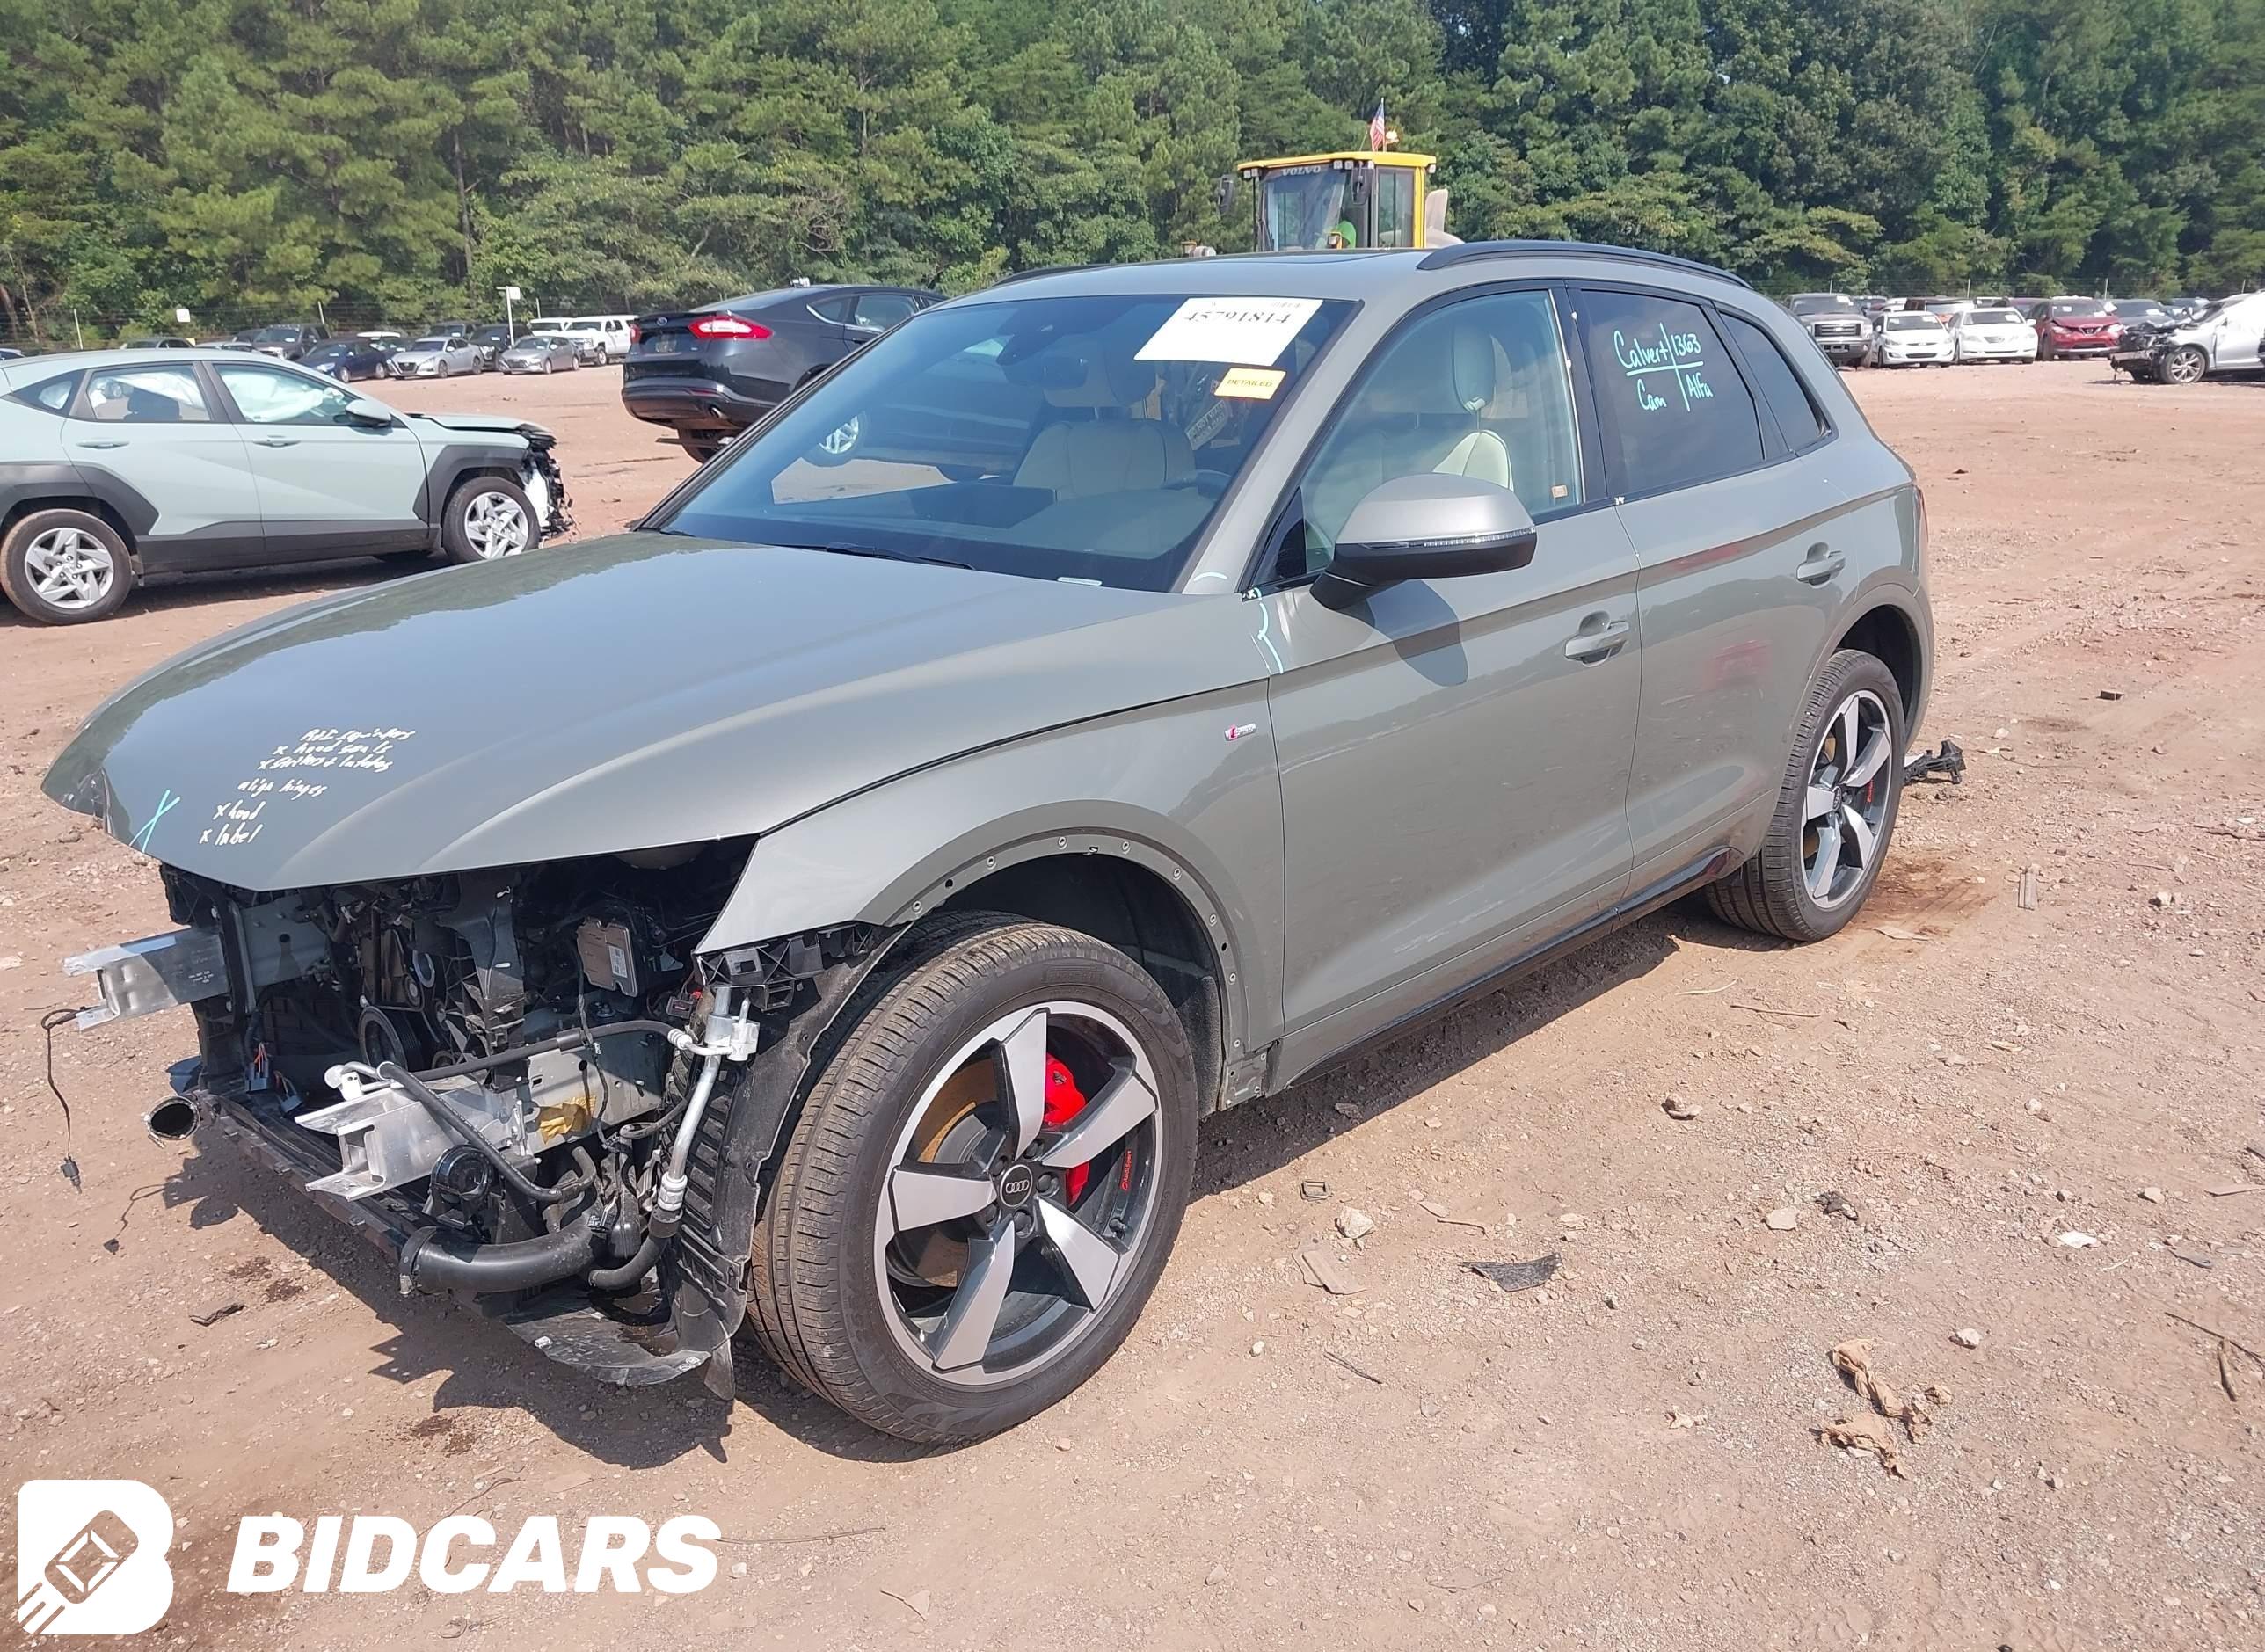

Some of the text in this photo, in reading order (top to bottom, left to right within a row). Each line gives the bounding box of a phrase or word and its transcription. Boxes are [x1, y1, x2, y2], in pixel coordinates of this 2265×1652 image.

[1281, 166, 1322, 176] VOLVO
[1613, 330, 1701, 368] Calvert 1363
[1227, 379, 1272, 388] DETAILED
[1685, 372, 1714, 399] Alfa
[237, 777, 328, 801] align hinges
[228, 799, 266, 821] hood
[215, 821, 264, 846] label
